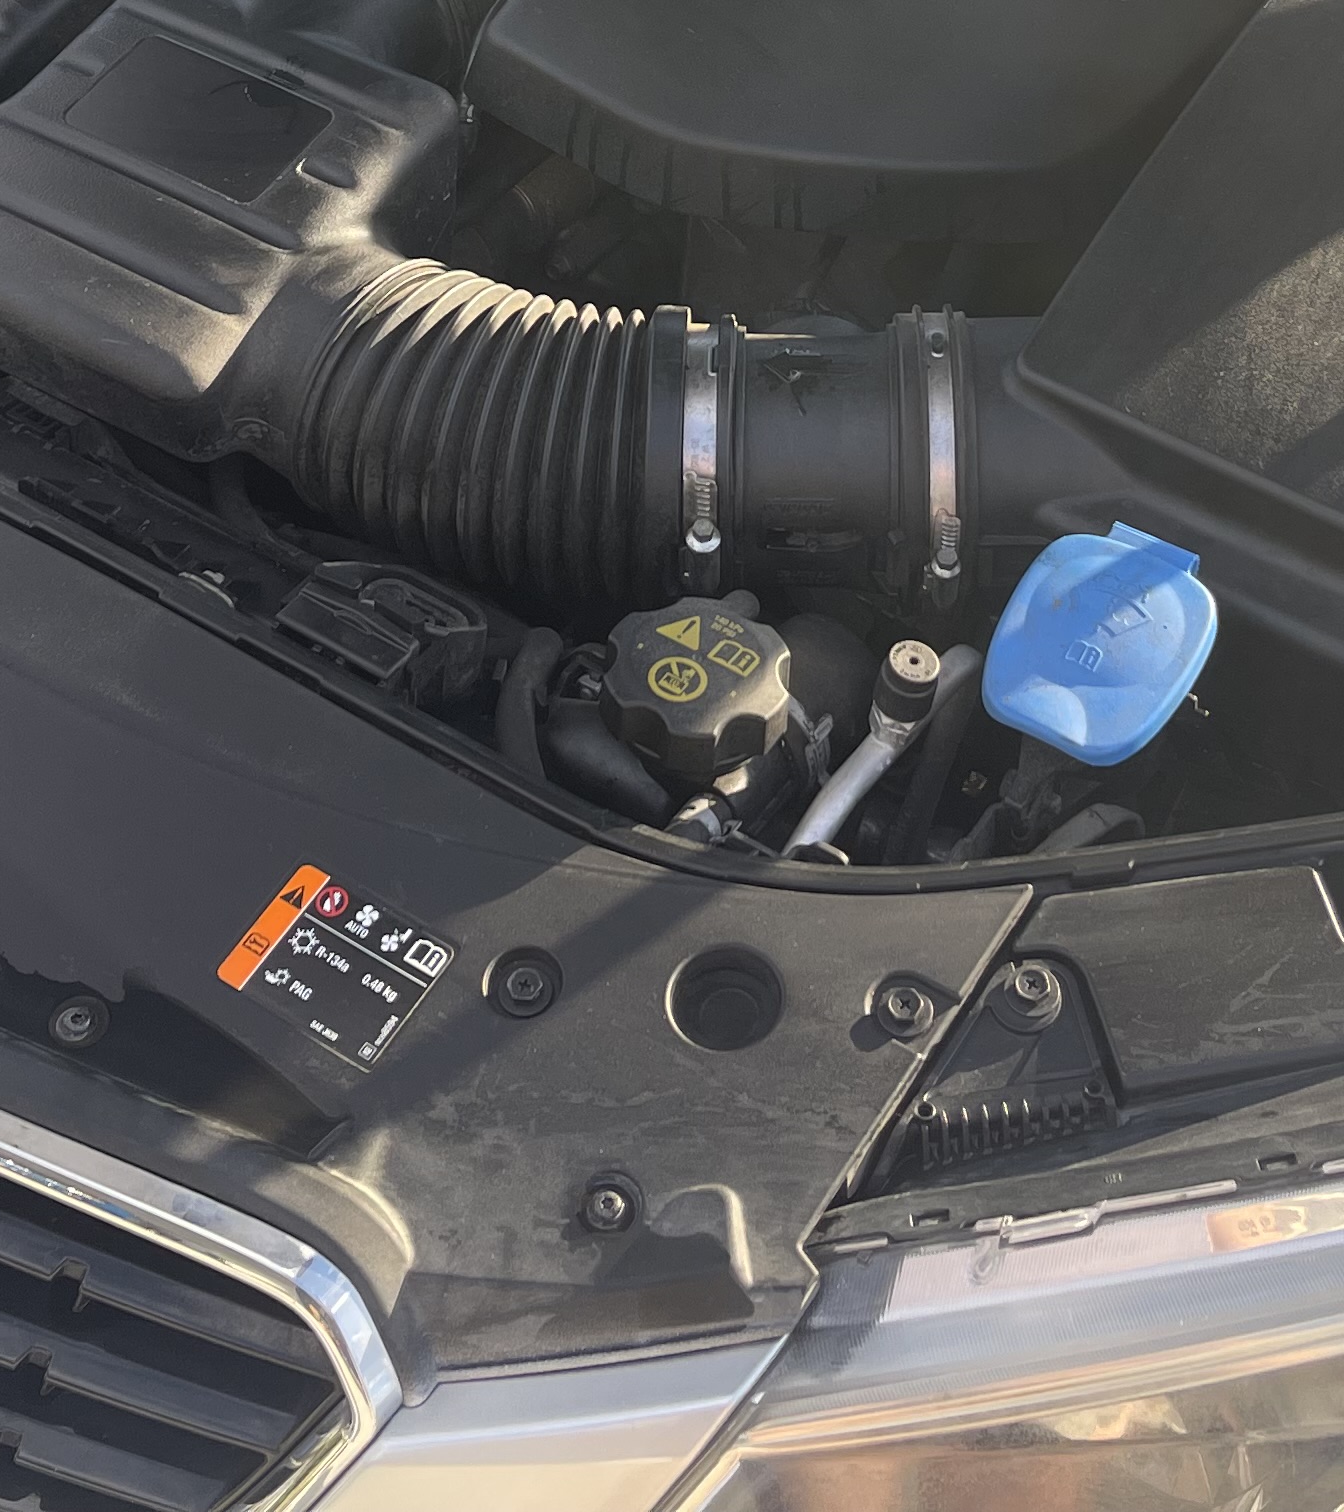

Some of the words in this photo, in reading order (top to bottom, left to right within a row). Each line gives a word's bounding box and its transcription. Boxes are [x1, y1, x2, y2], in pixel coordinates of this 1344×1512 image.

[344, 919, 369, 939] AUTO
[315, 945, 350, 973] R-134a
[288, 979, 313, 1001] PAG
[381, 985, 398, 1003] kg
